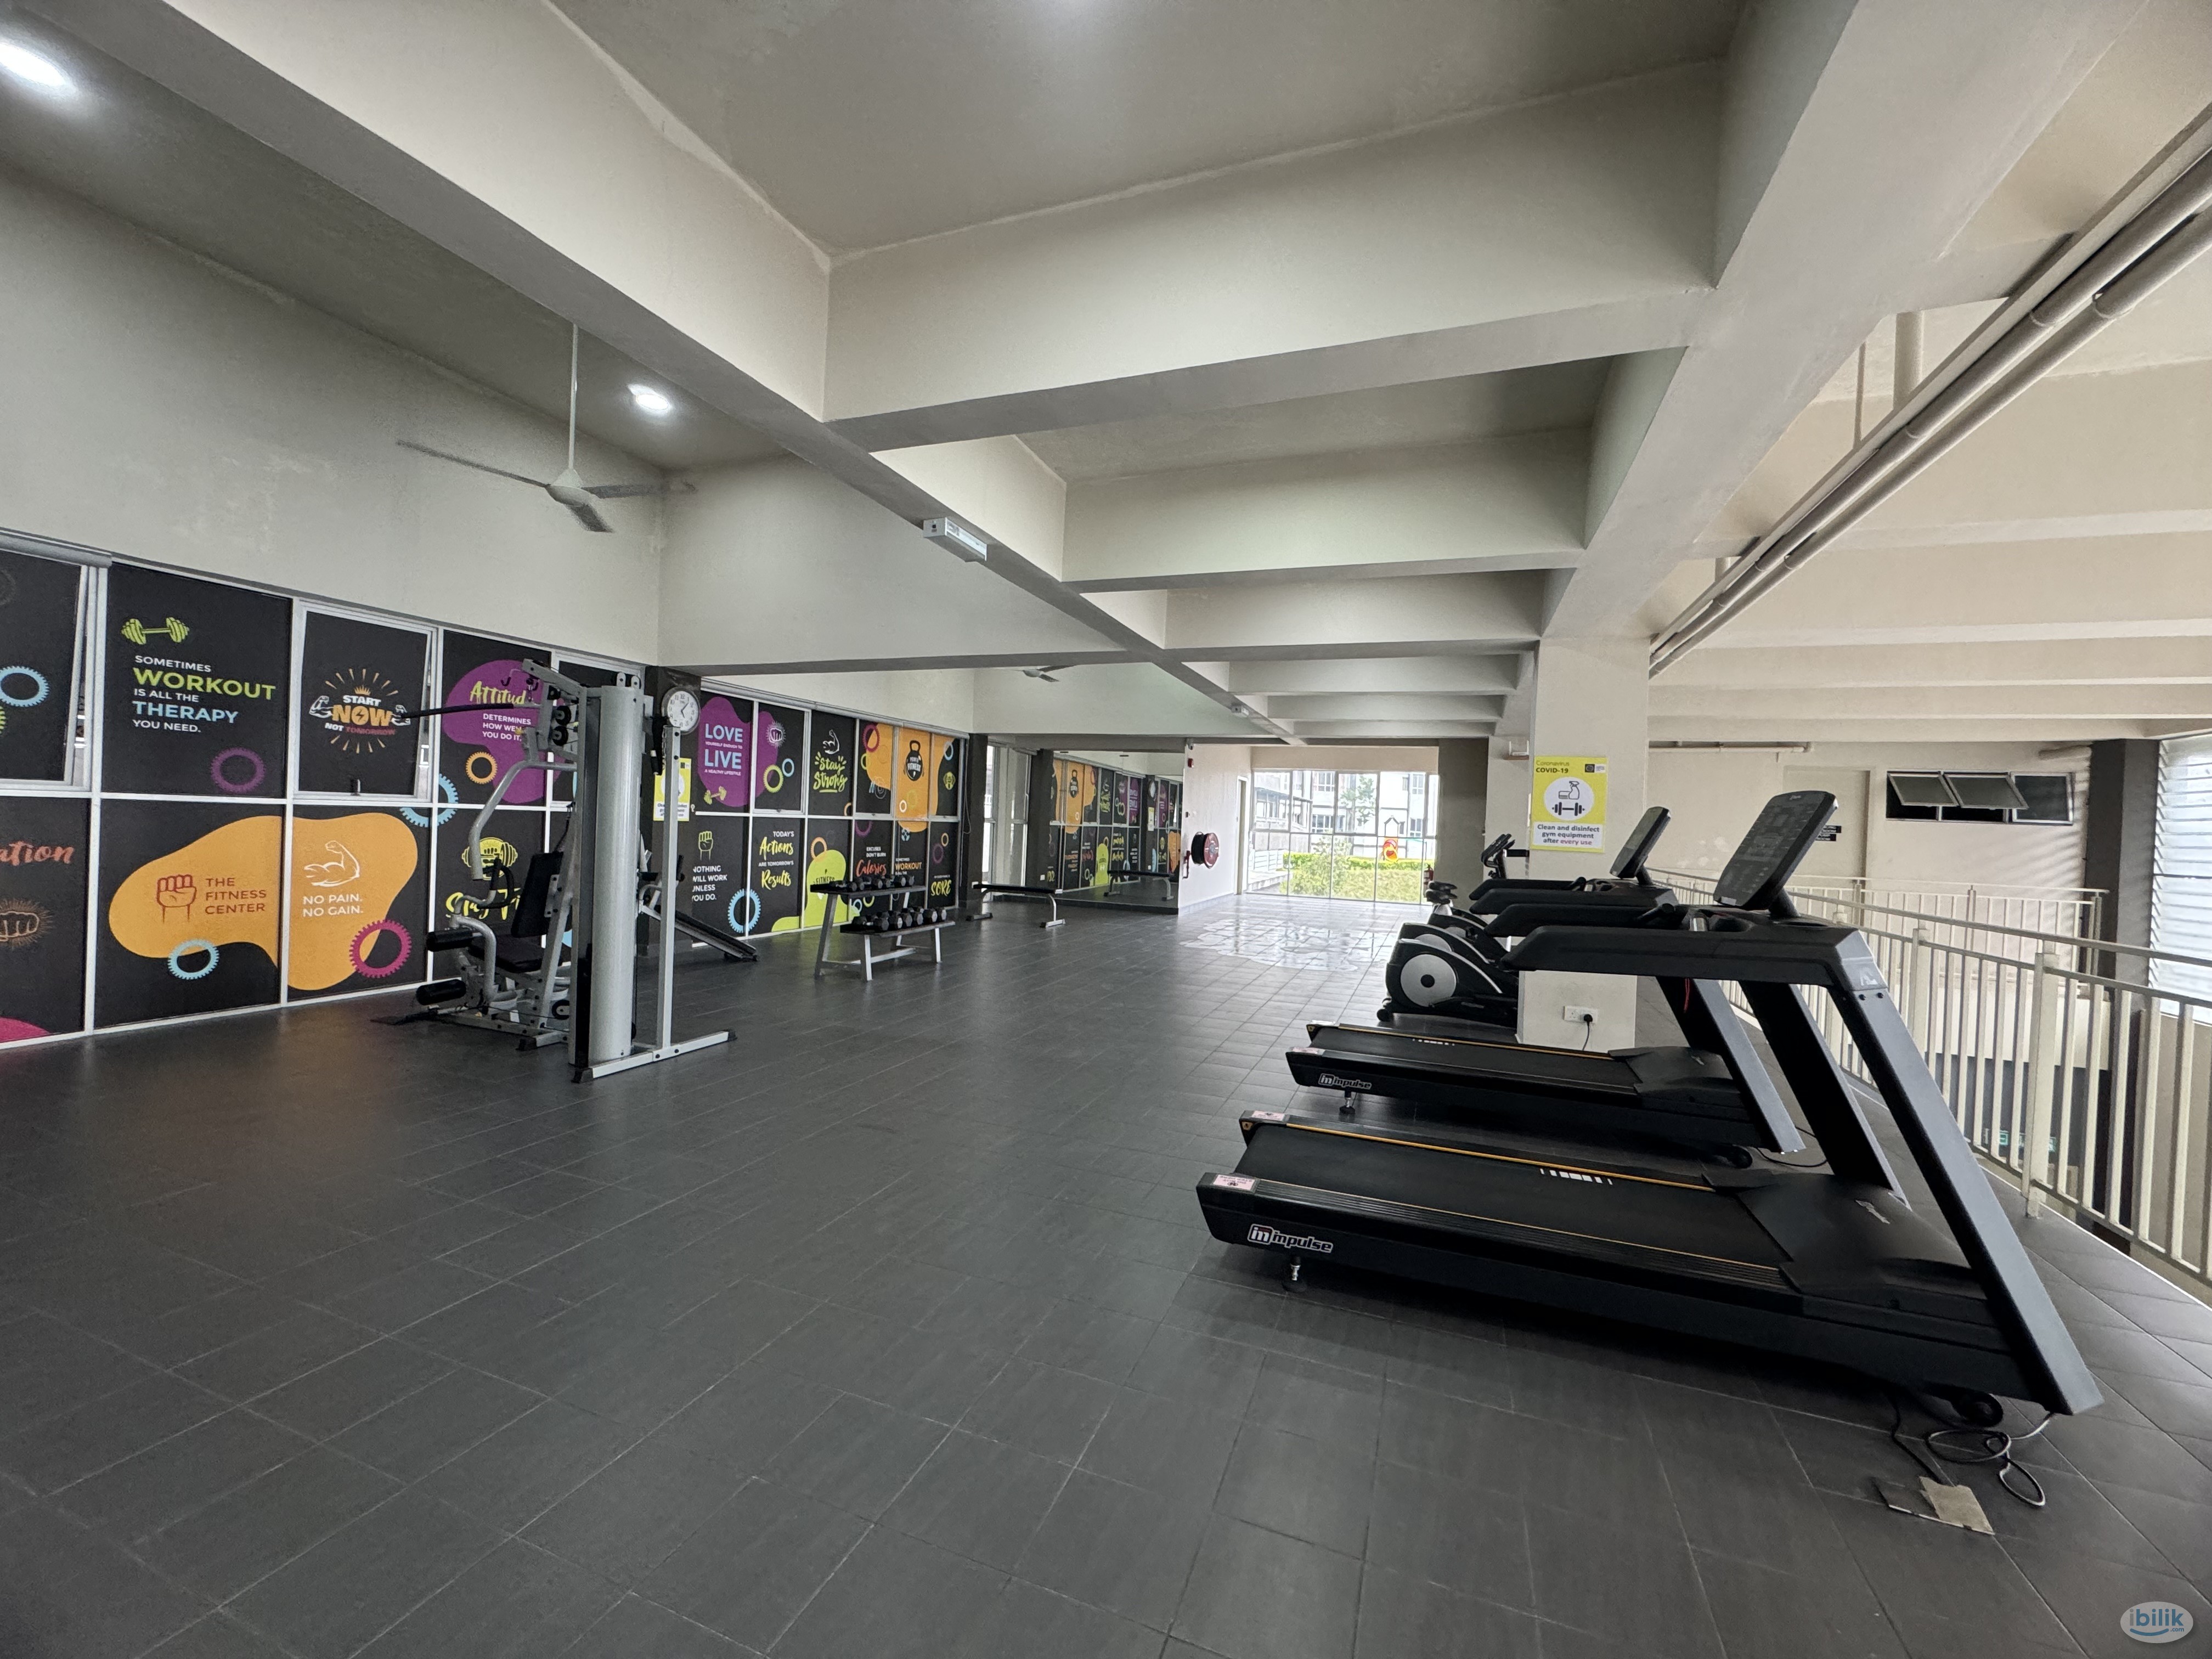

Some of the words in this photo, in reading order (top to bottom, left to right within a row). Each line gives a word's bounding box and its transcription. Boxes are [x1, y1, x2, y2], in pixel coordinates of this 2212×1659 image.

[134, 655, 211, 673] SOMETIMES
[133, 667, 276, 701] WORKOUT
[149, 690, 173, 699] ALL
[176, 693, 199, 703] THE
[470, 681, 527, 704] Attitud
[343, 695, 381, 706] START
[132, 701, 238, 723] THERAPY
[332, 704, 393, 726] NOW
[483, 713, 531, 725] DETERMINES
[132, 719, 160, 729] YOU
[164, 722, 201, 732] NEED.
[325, 723, 344, 731] NOT
[504, 724, 522, 733] WE
[705, 723, 743, 743] LOVE
[704, 749, 742, 769] LIVE
[820, 757, 845, 776] Stay
[813, 771, 848, 792] Strong
[759, 837, 793, 861] Actions
[895, 862, 922, 870] WORKOUT
[206, 878, 235, 887] THE
[761, 870, 791, 891] Results
[931, 879, 952, 896] SORE
[206, 890, 267, 901] FITNESS
[303, 895, 324, 905] NO
[329, 893, 363, 904] PAIN.
[205, 903, 265, 915] CENTER
[303, 908, 324, 917] NO
[328, 905, 363, 916] GAIN.
